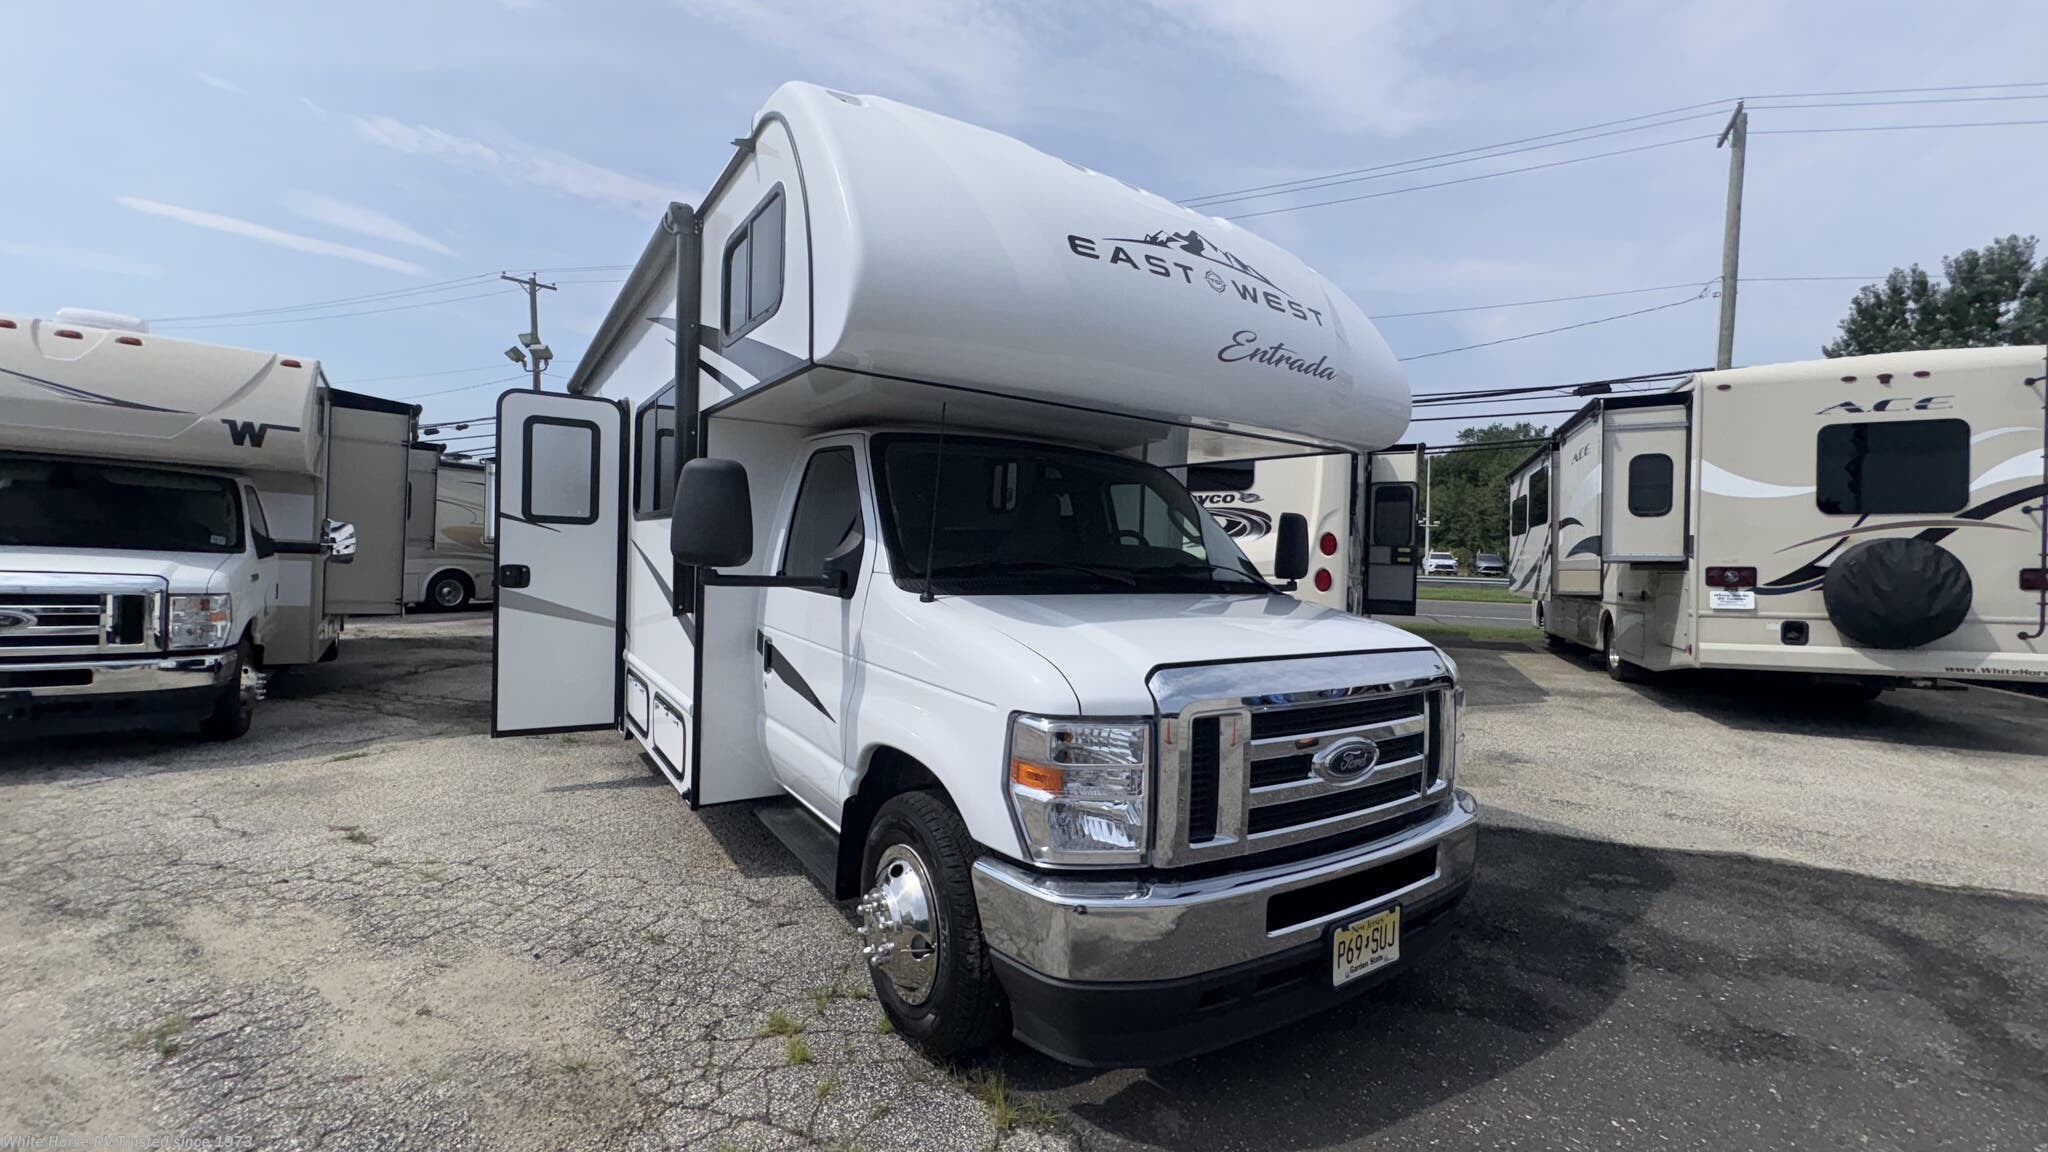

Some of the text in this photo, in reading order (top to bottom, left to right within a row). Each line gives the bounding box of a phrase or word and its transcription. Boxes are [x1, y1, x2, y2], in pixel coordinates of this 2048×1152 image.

[1068, 235, 1194, 284] EAST
[1231, 279, 1323, 326] WEST
[1217, 330, 1337, 381] Entrada
[221, 418, 300, 448] W
[1191, 494, 1235, 507] yco
[1340, 750, 1368, 770] Ford
